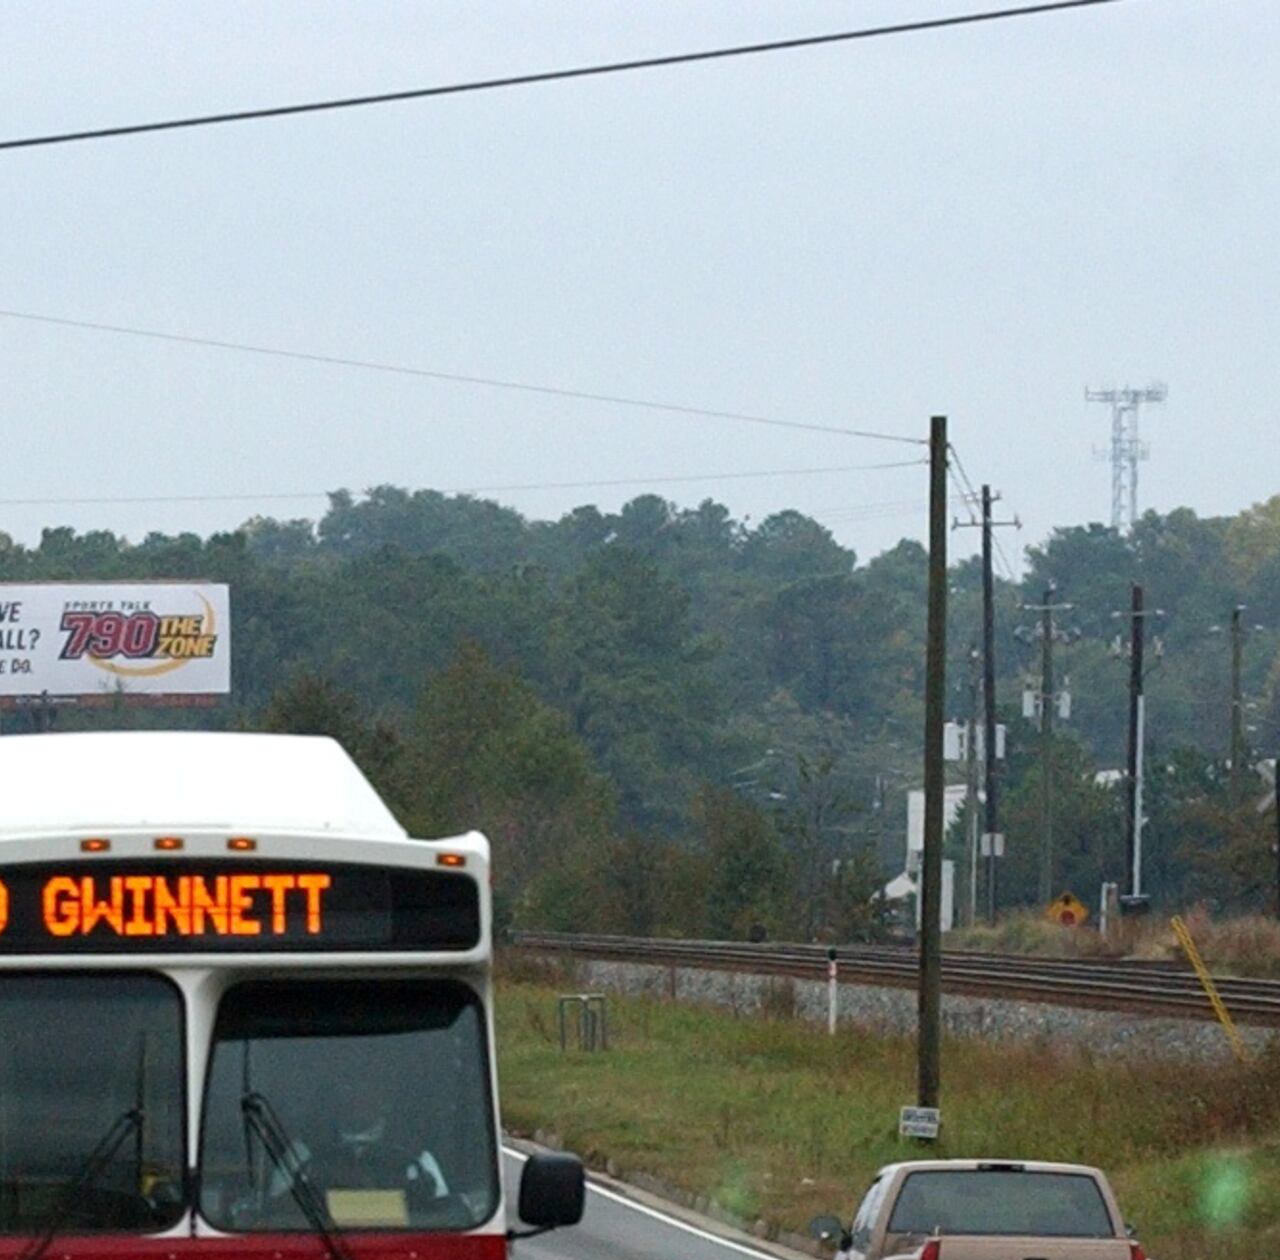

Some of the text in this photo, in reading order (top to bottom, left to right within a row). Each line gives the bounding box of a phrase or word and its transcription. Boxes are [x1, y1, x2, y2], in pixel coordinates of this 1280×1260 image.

[58, 611, 161, 660] 790
[160, 615, 204, 635] THE
[152, 635, 218, 659] ZONE
[43, 875, 331, 936] GWINNETT
